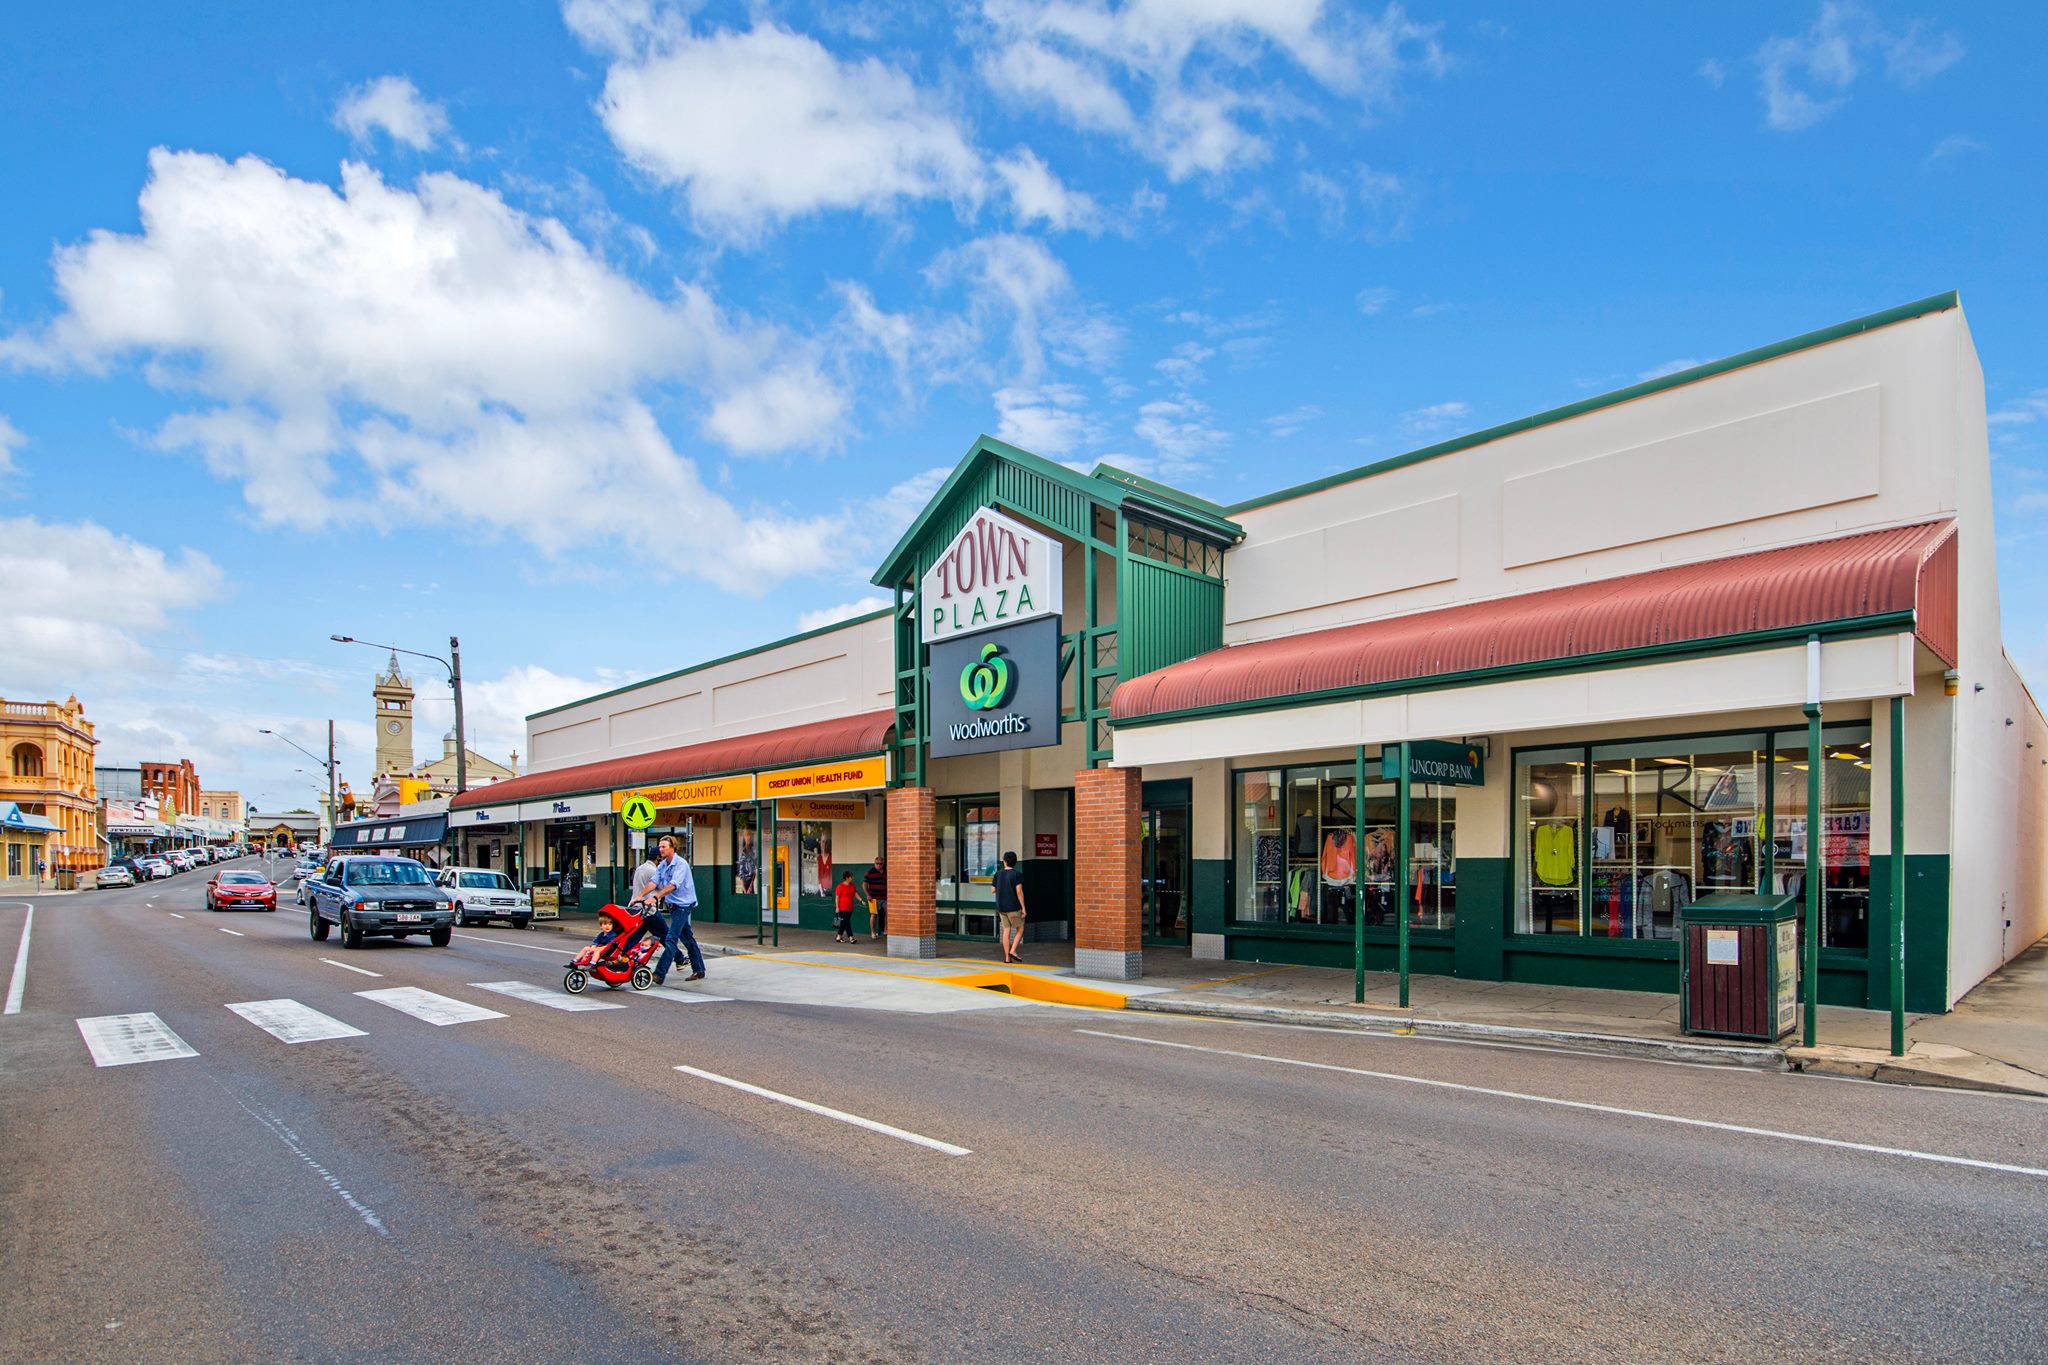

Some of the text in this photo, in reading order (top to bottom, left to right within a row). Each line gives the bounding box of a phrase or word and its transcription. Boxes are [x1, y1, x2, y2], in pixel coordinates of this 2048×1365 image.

[937, 517, 1031, 599] TOWN
[933, 584, 1036, 634] PLAZA
[768, 770, 864, 789] CREDIT UNION HEALTH FUND
[1449, 763, 1473, 780] BANK
[809, 801, 855, 811] Queensland
[810, 810, 855, 818] COUNTRY
[677, 812, 708, 824] ATM
